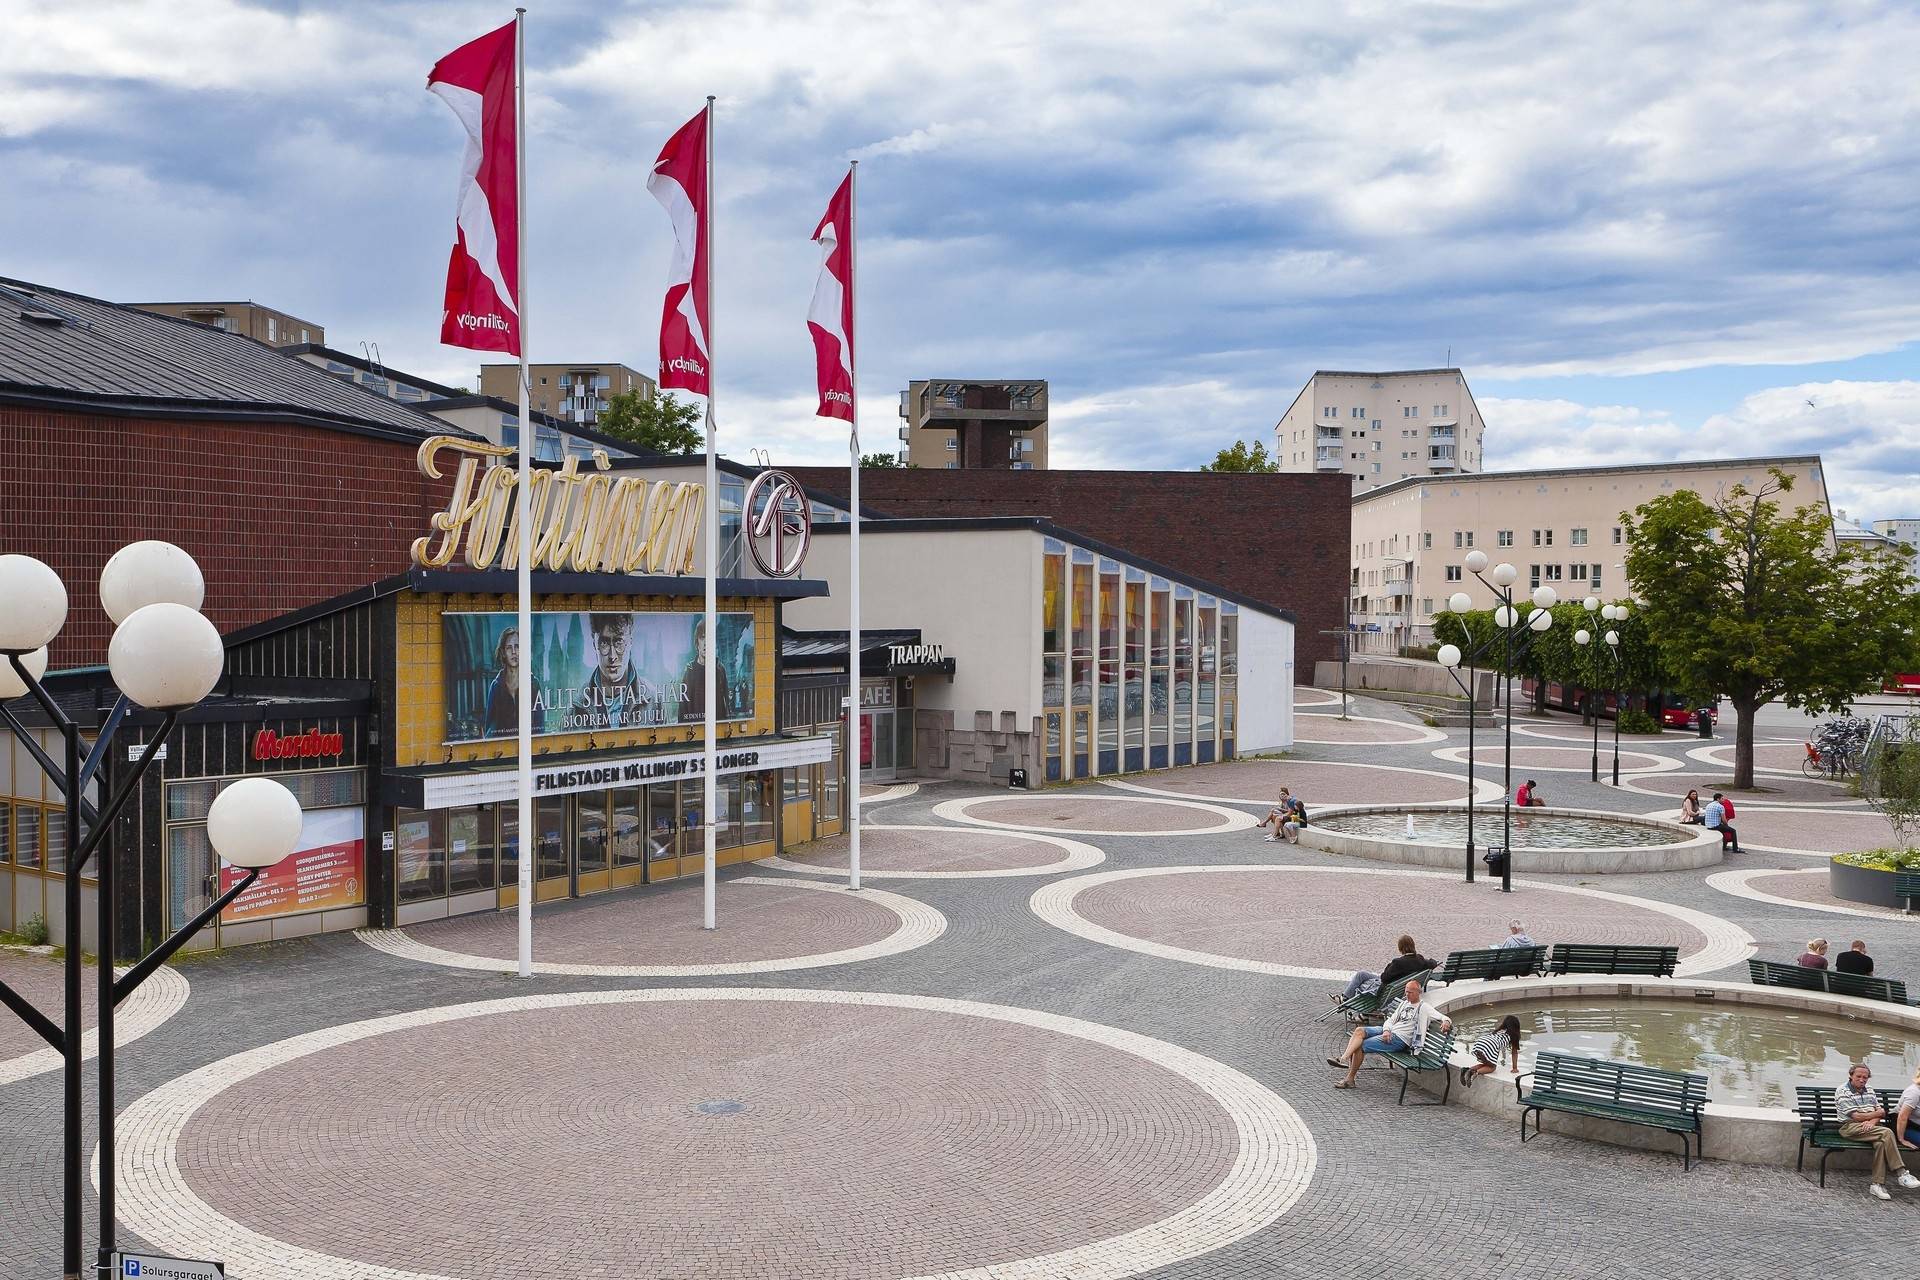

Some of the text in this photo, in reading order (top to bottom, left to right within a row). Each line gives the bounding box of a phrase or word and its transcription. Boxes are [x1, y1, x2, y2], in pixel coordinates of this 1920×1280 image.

[888, 644, 944, 664] TRAPPAN
[531, 680, 691, 712] ALLT SLUTAR HÄR
[633, 711, 642, 722] 13
[644, 709, 665, 722] JULI
[255, 727, 344, 761] Marabou
[536, 752, 760, 791] FILMSTADEN VÄLLINGBY 5 SLONGER
